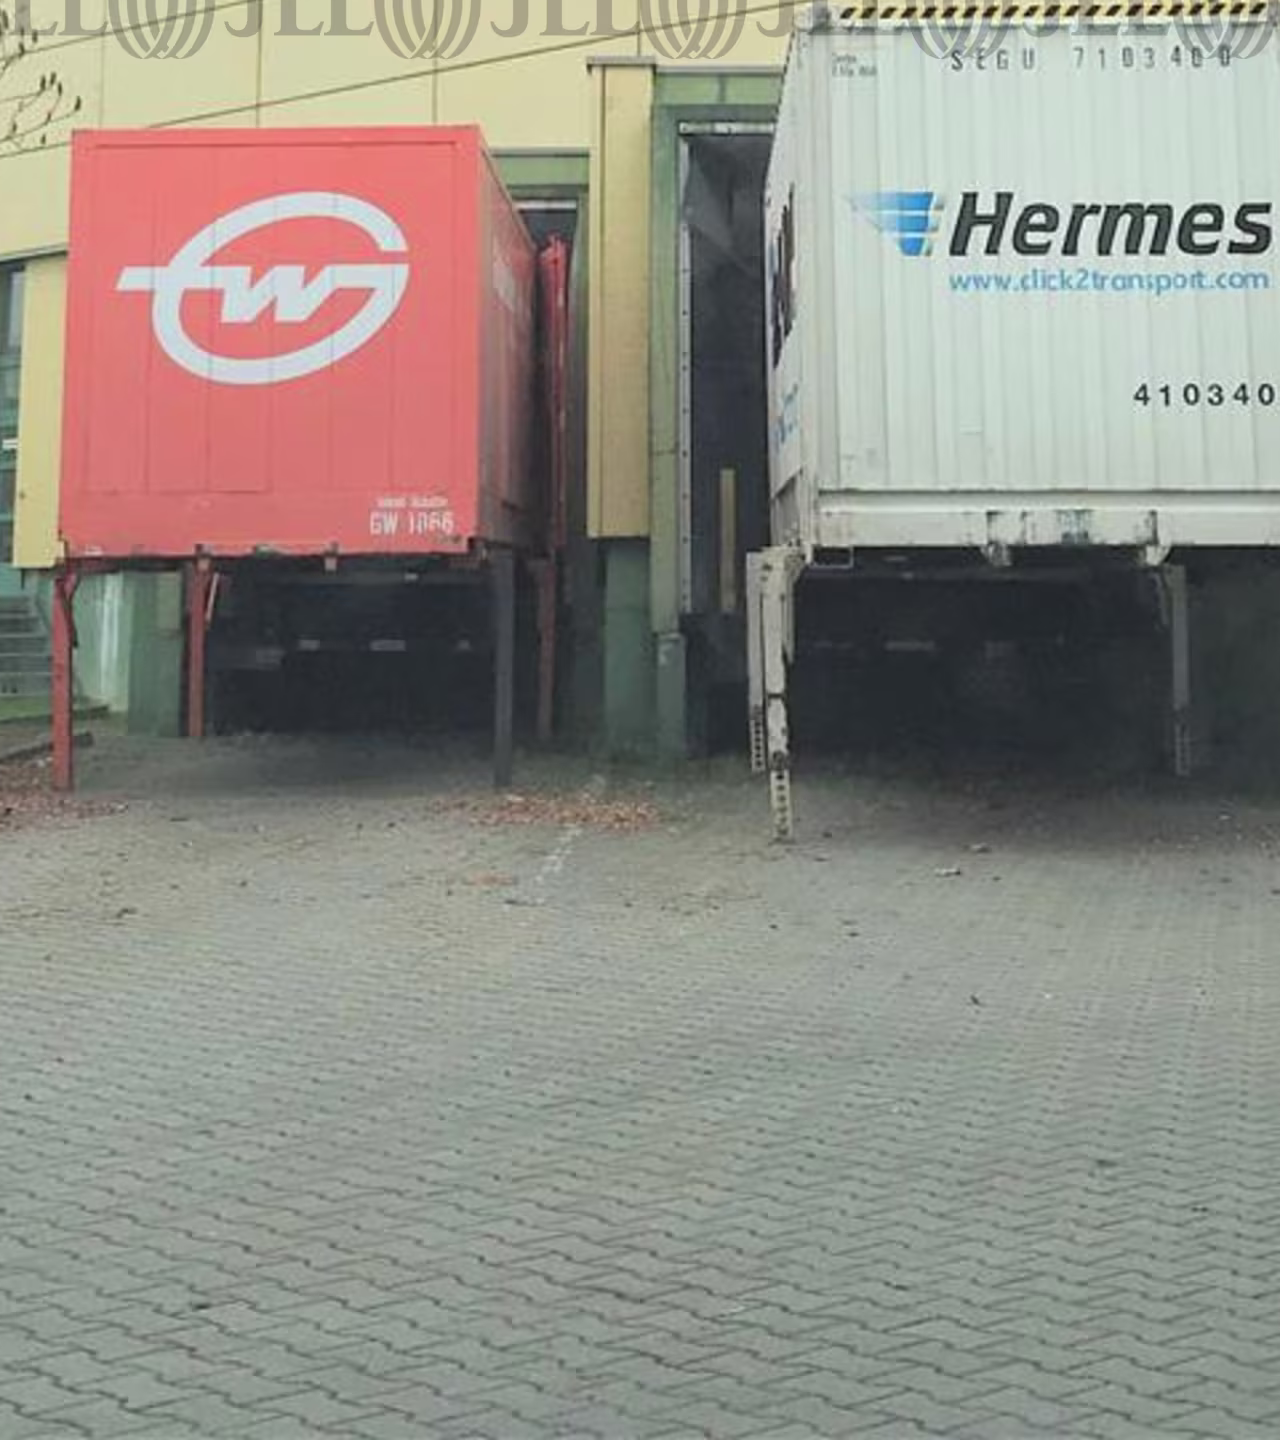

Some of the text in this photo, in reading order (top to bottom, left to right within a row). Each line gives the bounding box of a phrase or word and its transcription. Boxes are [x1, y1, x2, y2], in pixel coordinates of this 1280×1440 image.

[950, 47, 1036, 71] SEGU
[948, 190, 1273, 257] Hermes
[948, 267, 1271, 296] www.click2transport.com
[1132, 382, 1276, 406] 410340
